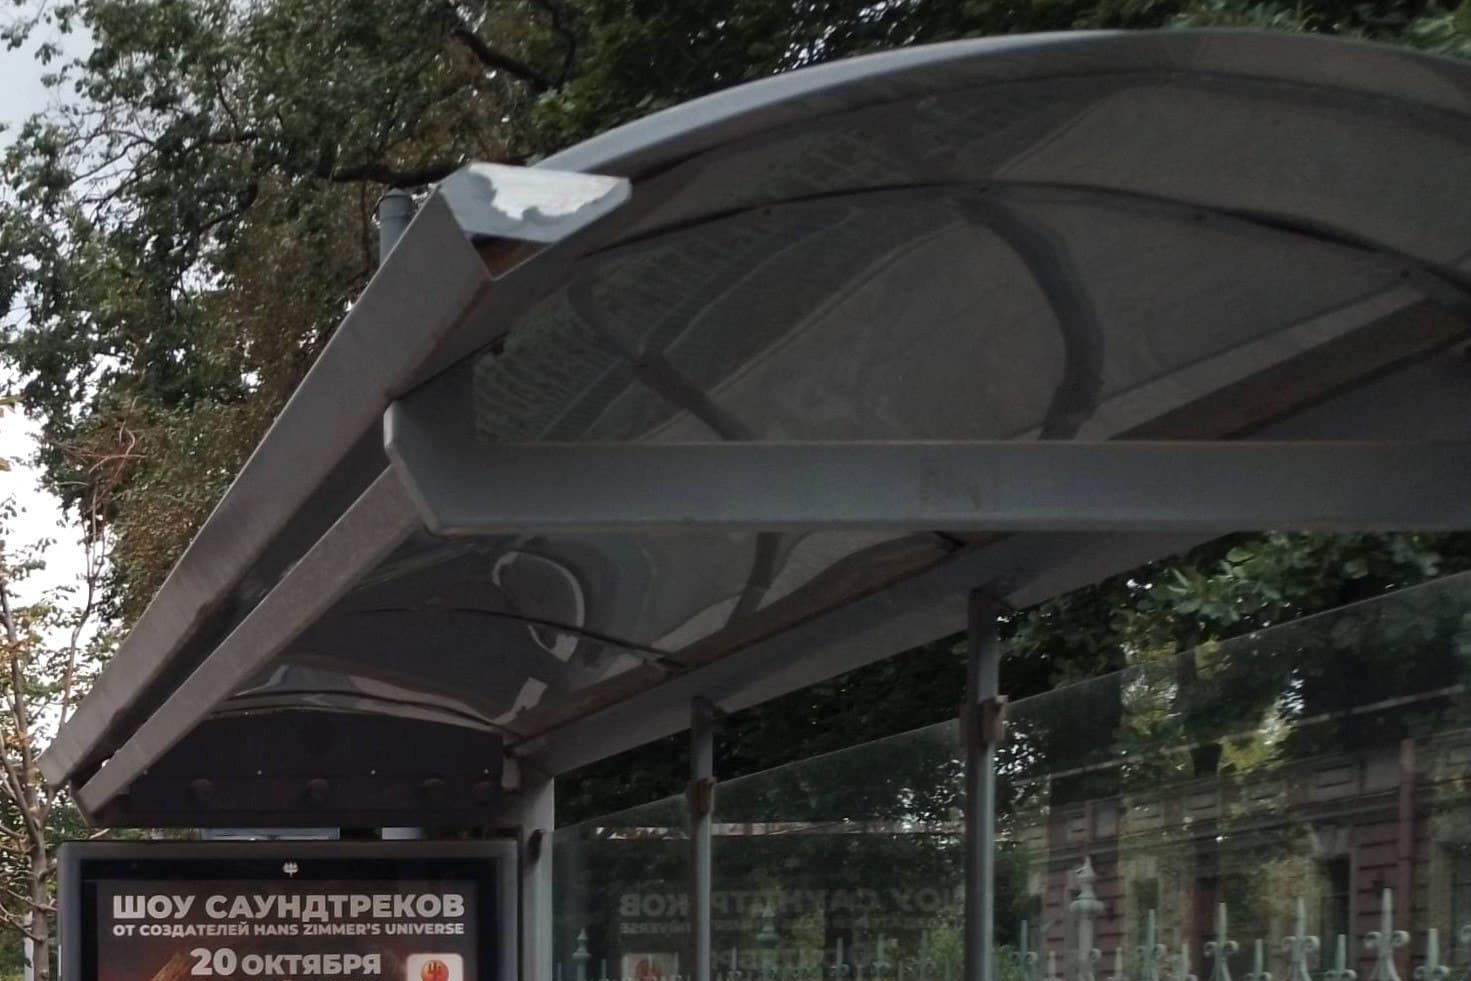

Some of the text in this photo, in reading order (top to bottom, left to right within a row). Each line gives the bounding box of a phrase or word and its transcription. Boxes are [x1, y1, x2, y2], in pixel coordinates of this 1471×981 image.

[113, 894, 464, 922] ШОУ САУНДТРЕКОВ
[113, 924, 135, 936] ОТ
[139, 921, 250, 937] СОЗДАТЕЛЕЙ
[254, 923, 298, 936] HANS
[385, 922, 464, 935] UNIVERSE
[189, 947, 381, 976] 20 ОКТЯБРЯ
